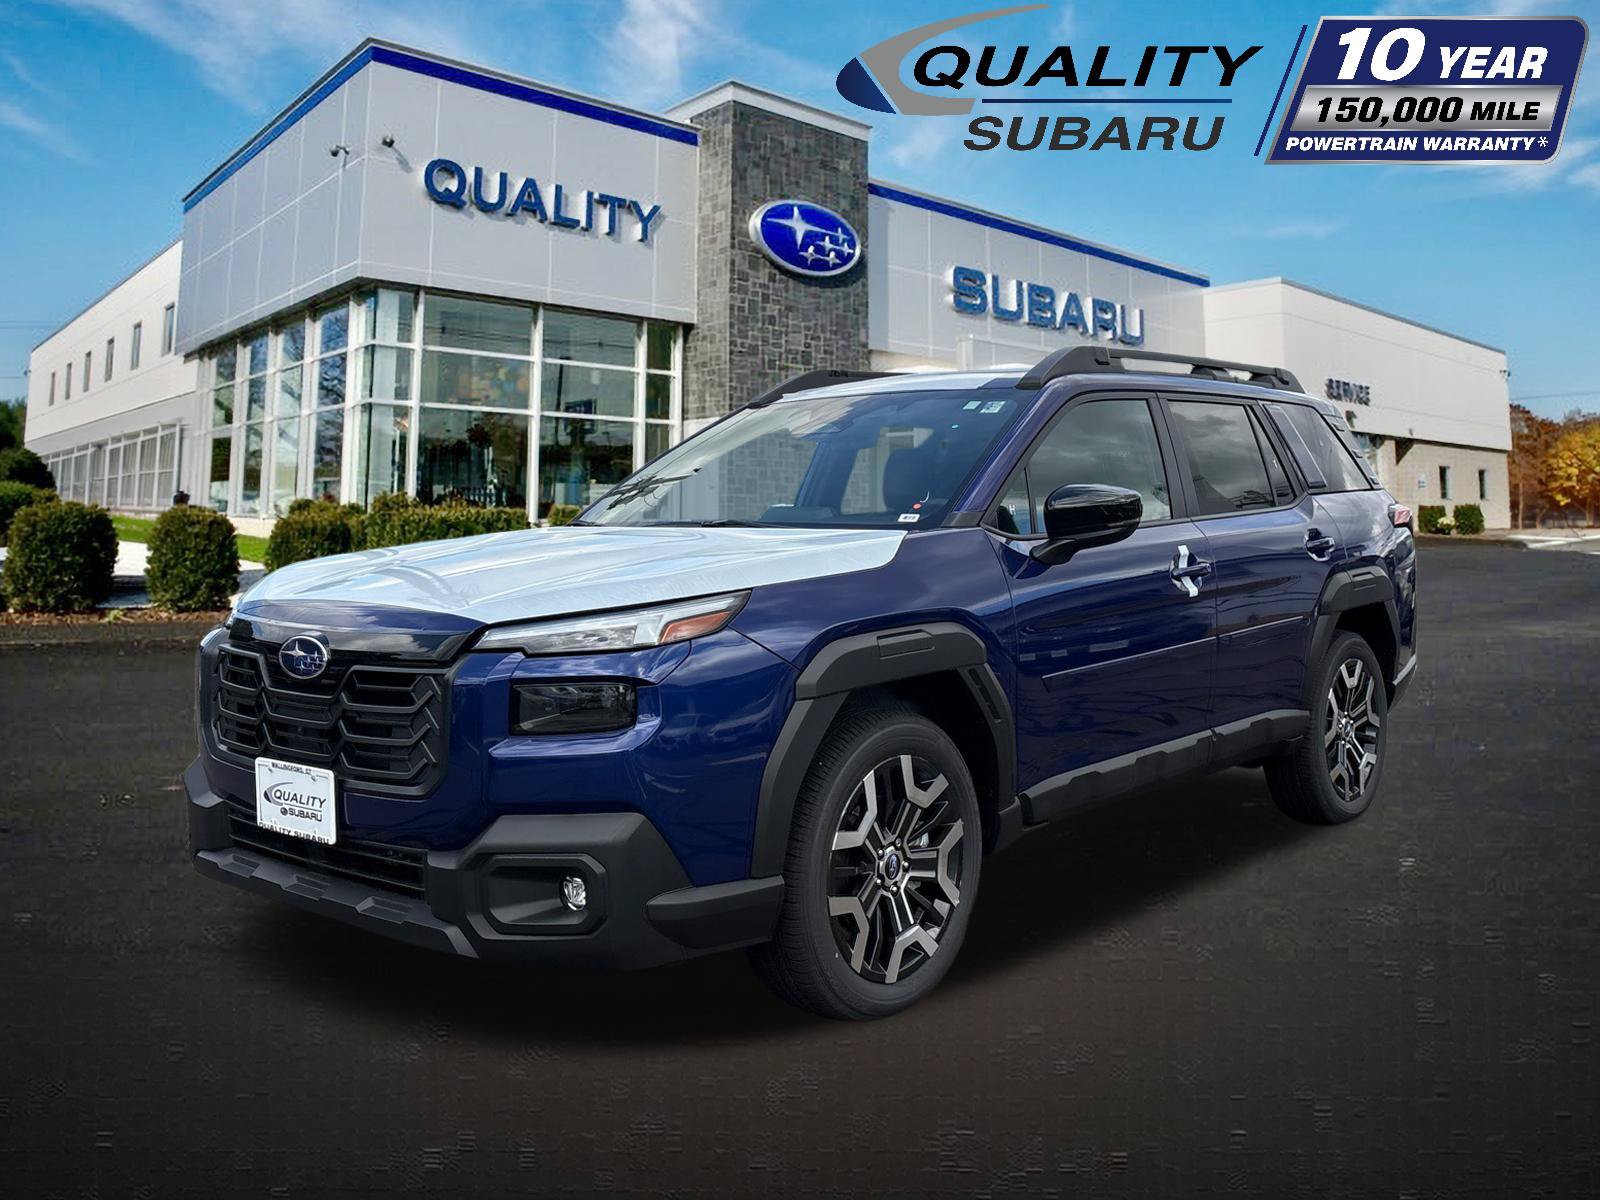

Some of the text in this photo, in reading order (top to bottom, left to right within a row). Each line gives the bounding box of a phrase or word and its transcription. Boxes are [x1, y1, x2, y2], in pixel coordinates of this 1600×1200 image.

[424, 158, 662, 243] QUALITY
[948, 265, 1146, 346] SUBARU
[1325, 378, 1371, 407] SERVICE
[273, 788, 327, 809] QUALITY
[288, 807, 323, 822] SUBARU
